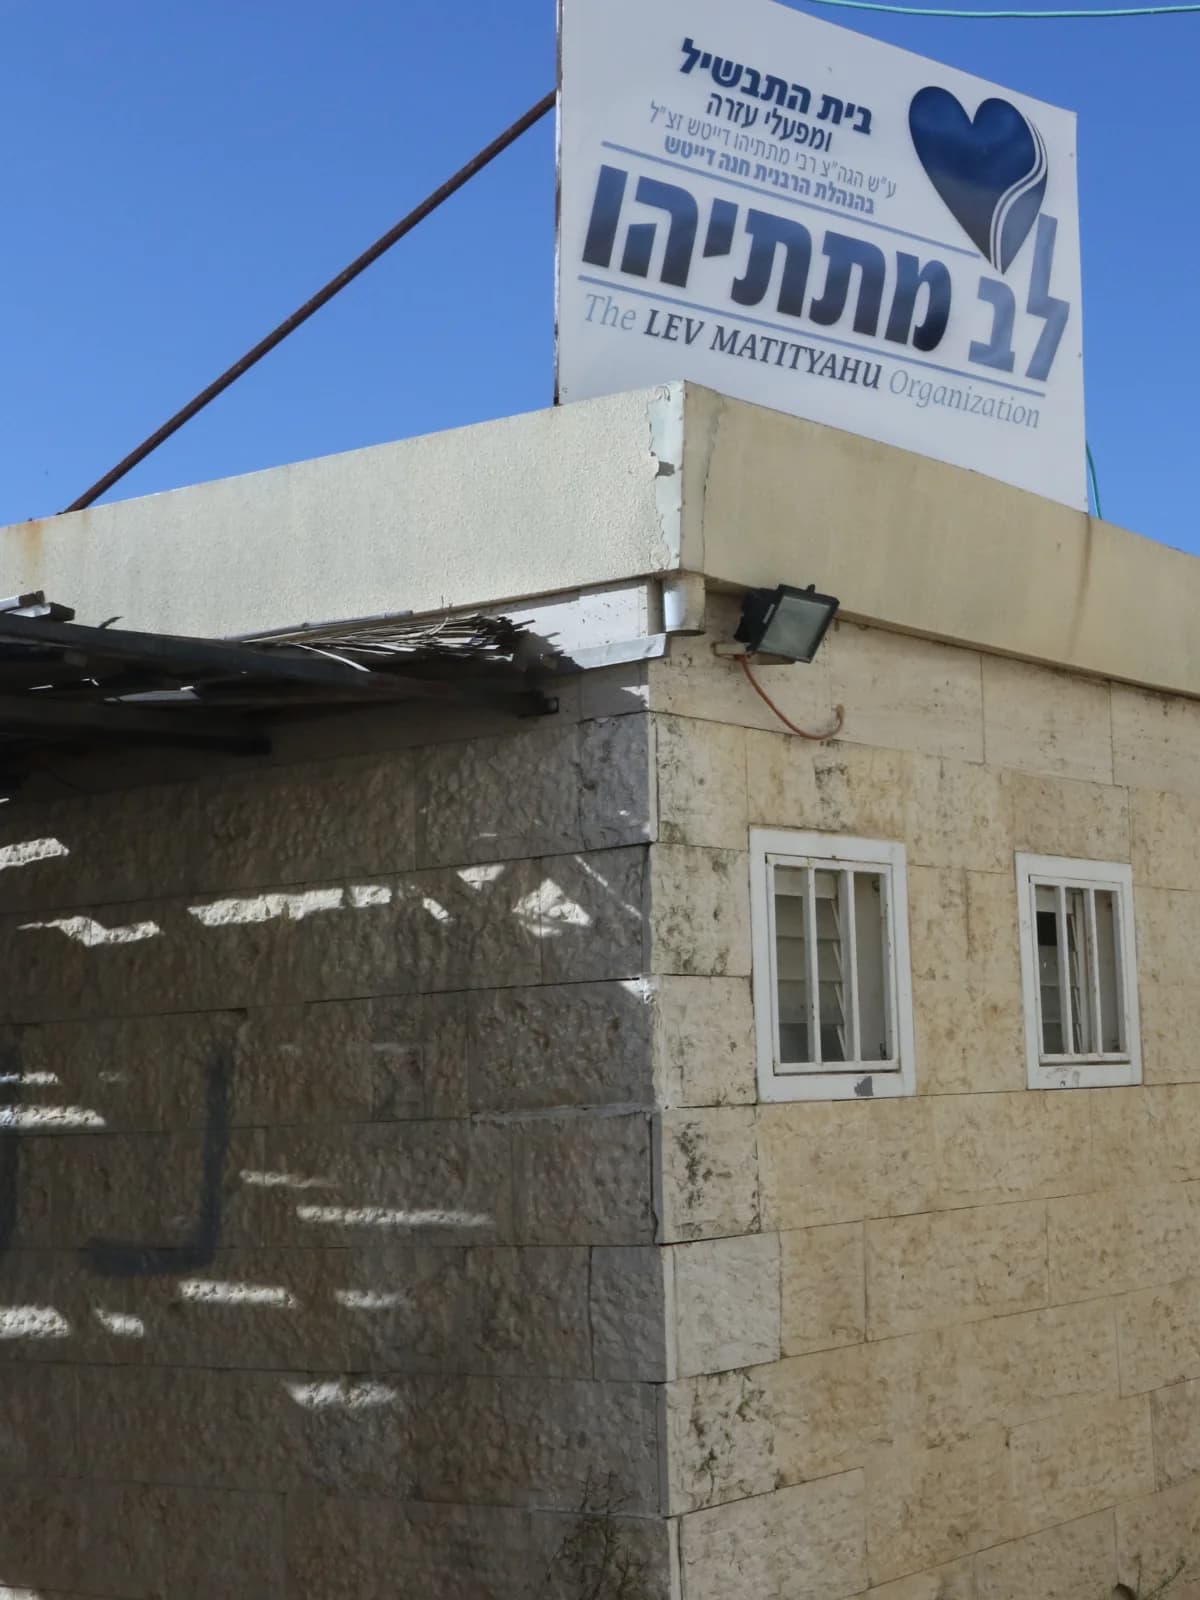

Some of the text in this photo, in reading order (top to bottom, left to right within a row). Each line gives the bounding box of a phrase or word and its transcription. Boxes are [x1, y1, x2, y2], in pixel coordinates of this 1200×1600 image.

[680, 37, 872, 135] בית התבשיל
[688, 117, 731, 146] דייטש
[706, 93, 832, 152] ומפעלי עזרה
[733, 133, 790, 166] מתתיהו
[664, 135, 874, 214] בהנהלת הרבנית חנה דייטש
[795, 152, 817, 174] רבי
[582, 164, 1070, 382] לב מתתיהו
[585, 294, 1040, 429] The LEV MATITYAHU Organization
